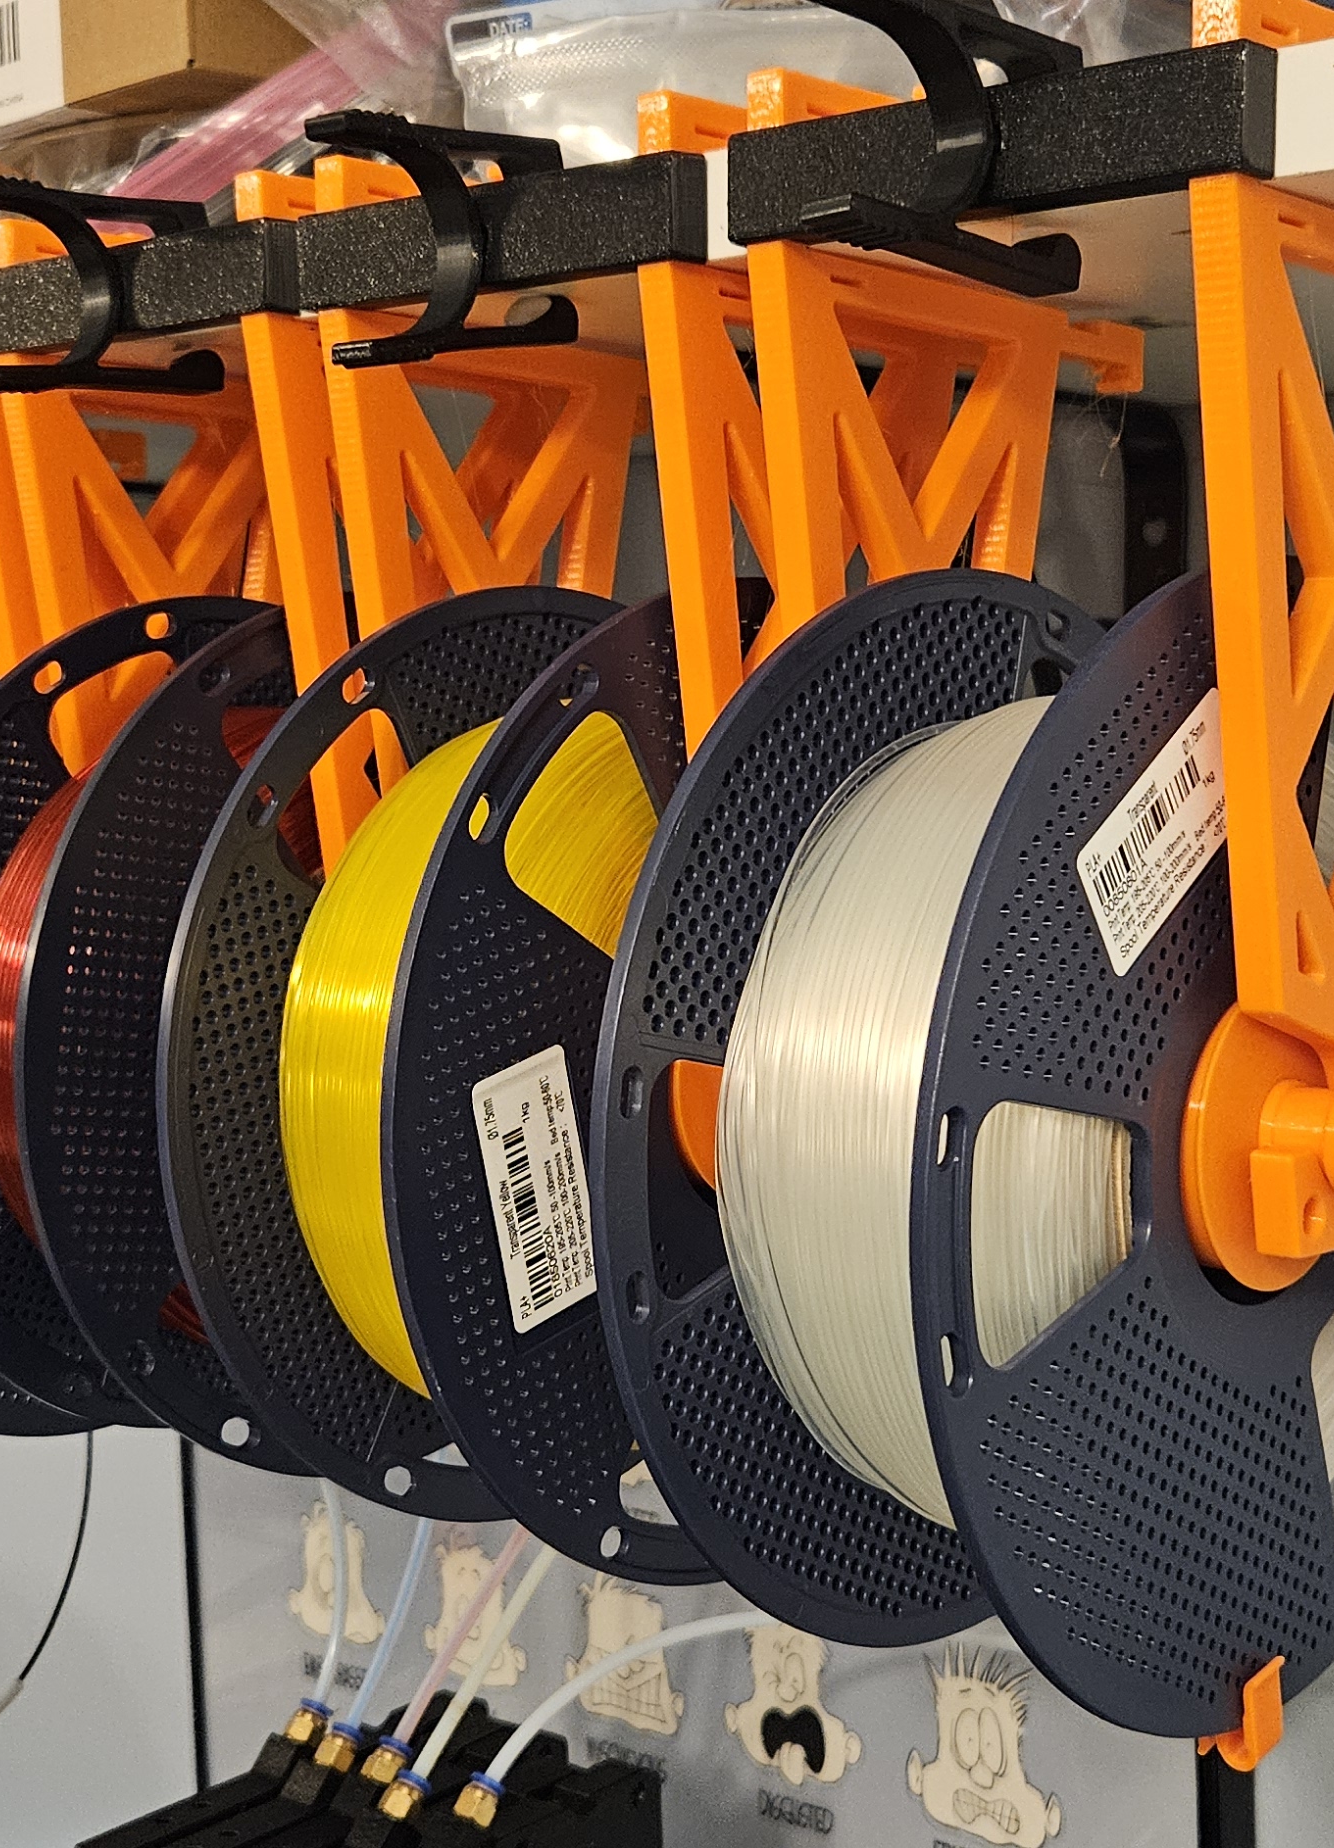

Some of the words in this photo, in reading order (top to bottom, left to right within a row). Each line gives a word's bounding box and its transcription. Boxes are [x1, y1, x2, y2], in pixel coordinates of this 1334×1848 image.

[1126, 780, 1160, 829] Transparent
[1084, 852, 1102, 878] PLA+
[1119, 928, 1139, 959] Spool
[1136, 883, 1175, 935] Temperature
[498, 1179, 512, 1211] Yellow
[502, 1205, 525, 1261] Transparent
[571, 1184, 588, 1249] Temperature
[580, 1247, 594, 1279] Spool
[519, 1295, 533, 1321] PLA+
